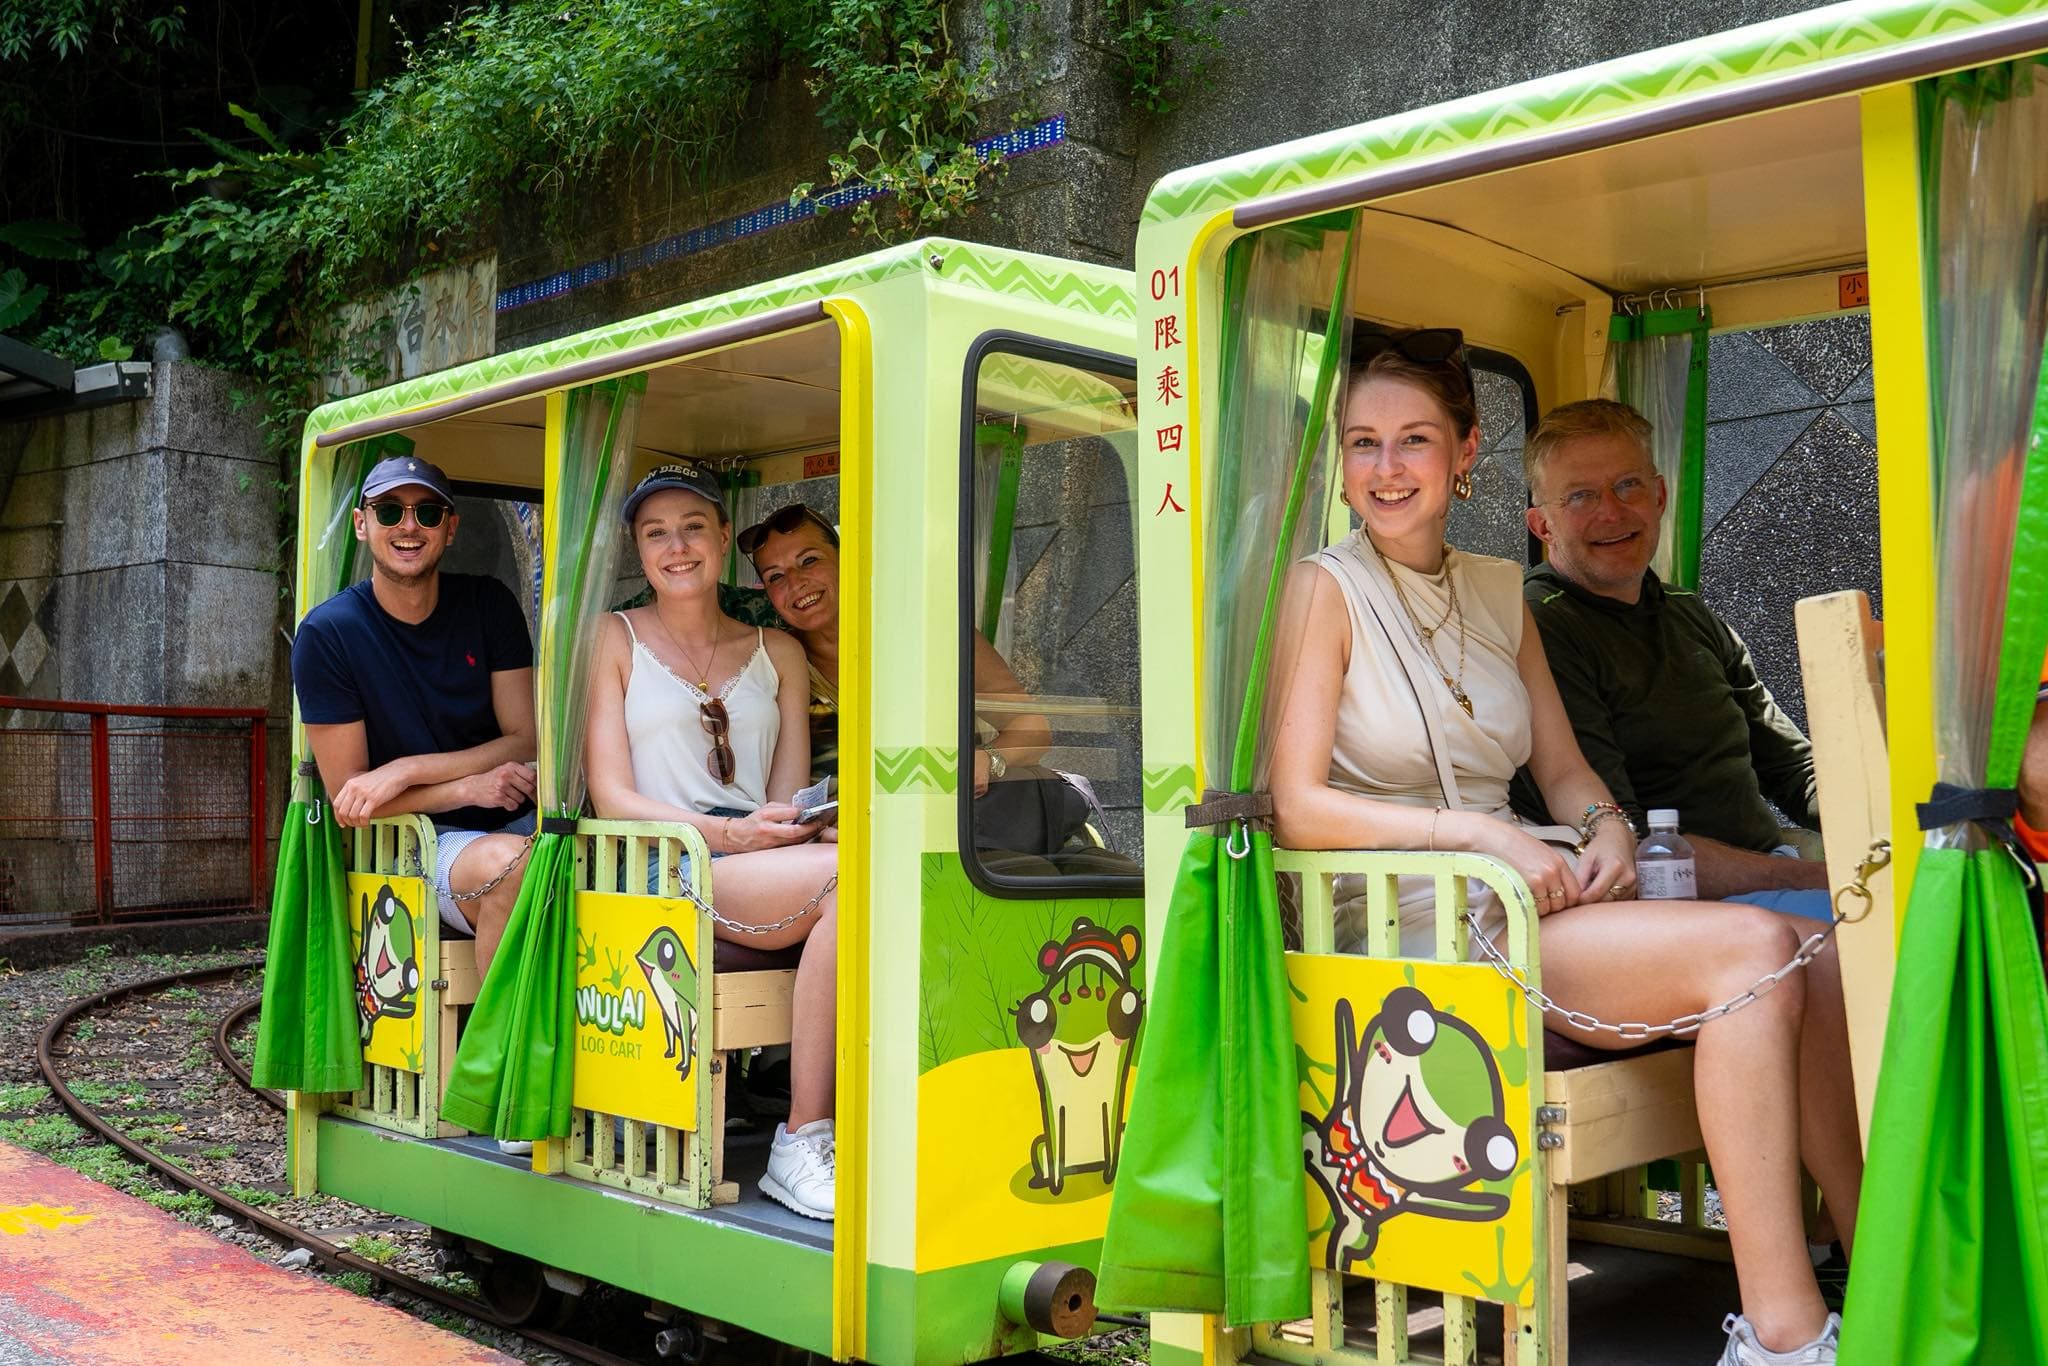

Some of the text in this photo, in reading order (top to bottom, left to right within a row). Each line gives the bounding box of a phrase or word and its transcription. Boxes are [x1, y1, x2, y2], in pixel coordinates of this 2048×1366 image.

[1151, 266, 1179, 301] 01
[1154, 315, 1186, 517] 限乘四人
[659, 464, 698, 478] DIEGO
[576, 984, 646, 1035] WULAI
[581, 1035, 642, 1060] LOG CART
